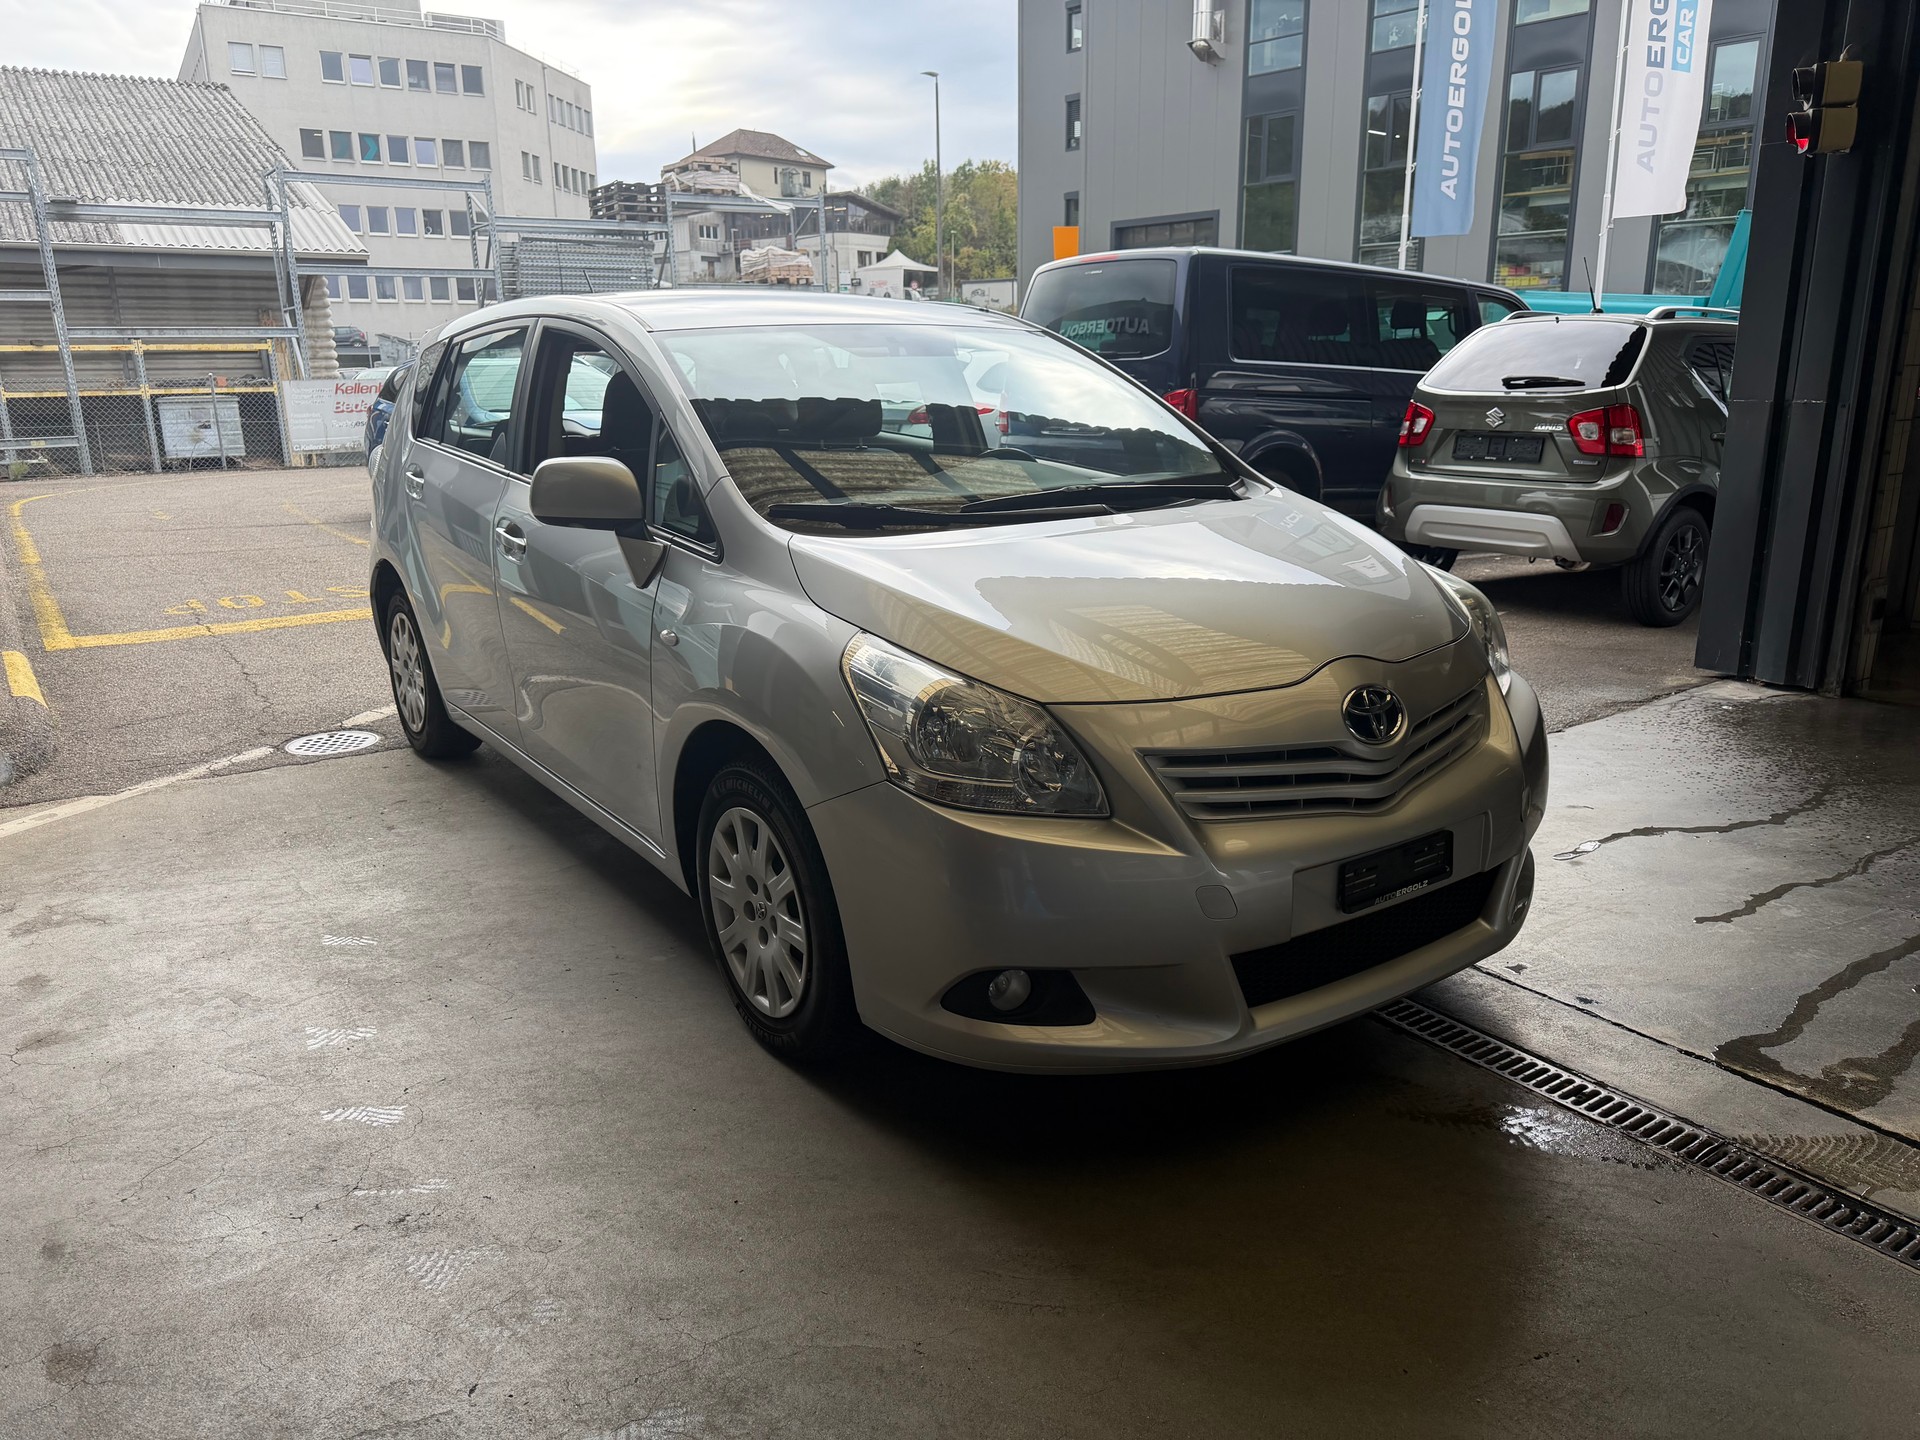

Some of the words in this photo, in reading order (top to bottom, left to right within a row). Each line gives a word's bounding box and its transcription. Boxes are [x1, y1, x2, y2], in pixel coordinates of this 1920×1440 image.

[1676, 8, 1694, 65] CAR
[726, 778, 771, 810] MICHELIN
[1375, 880, 1428, 905] AUTOERGOLZ
